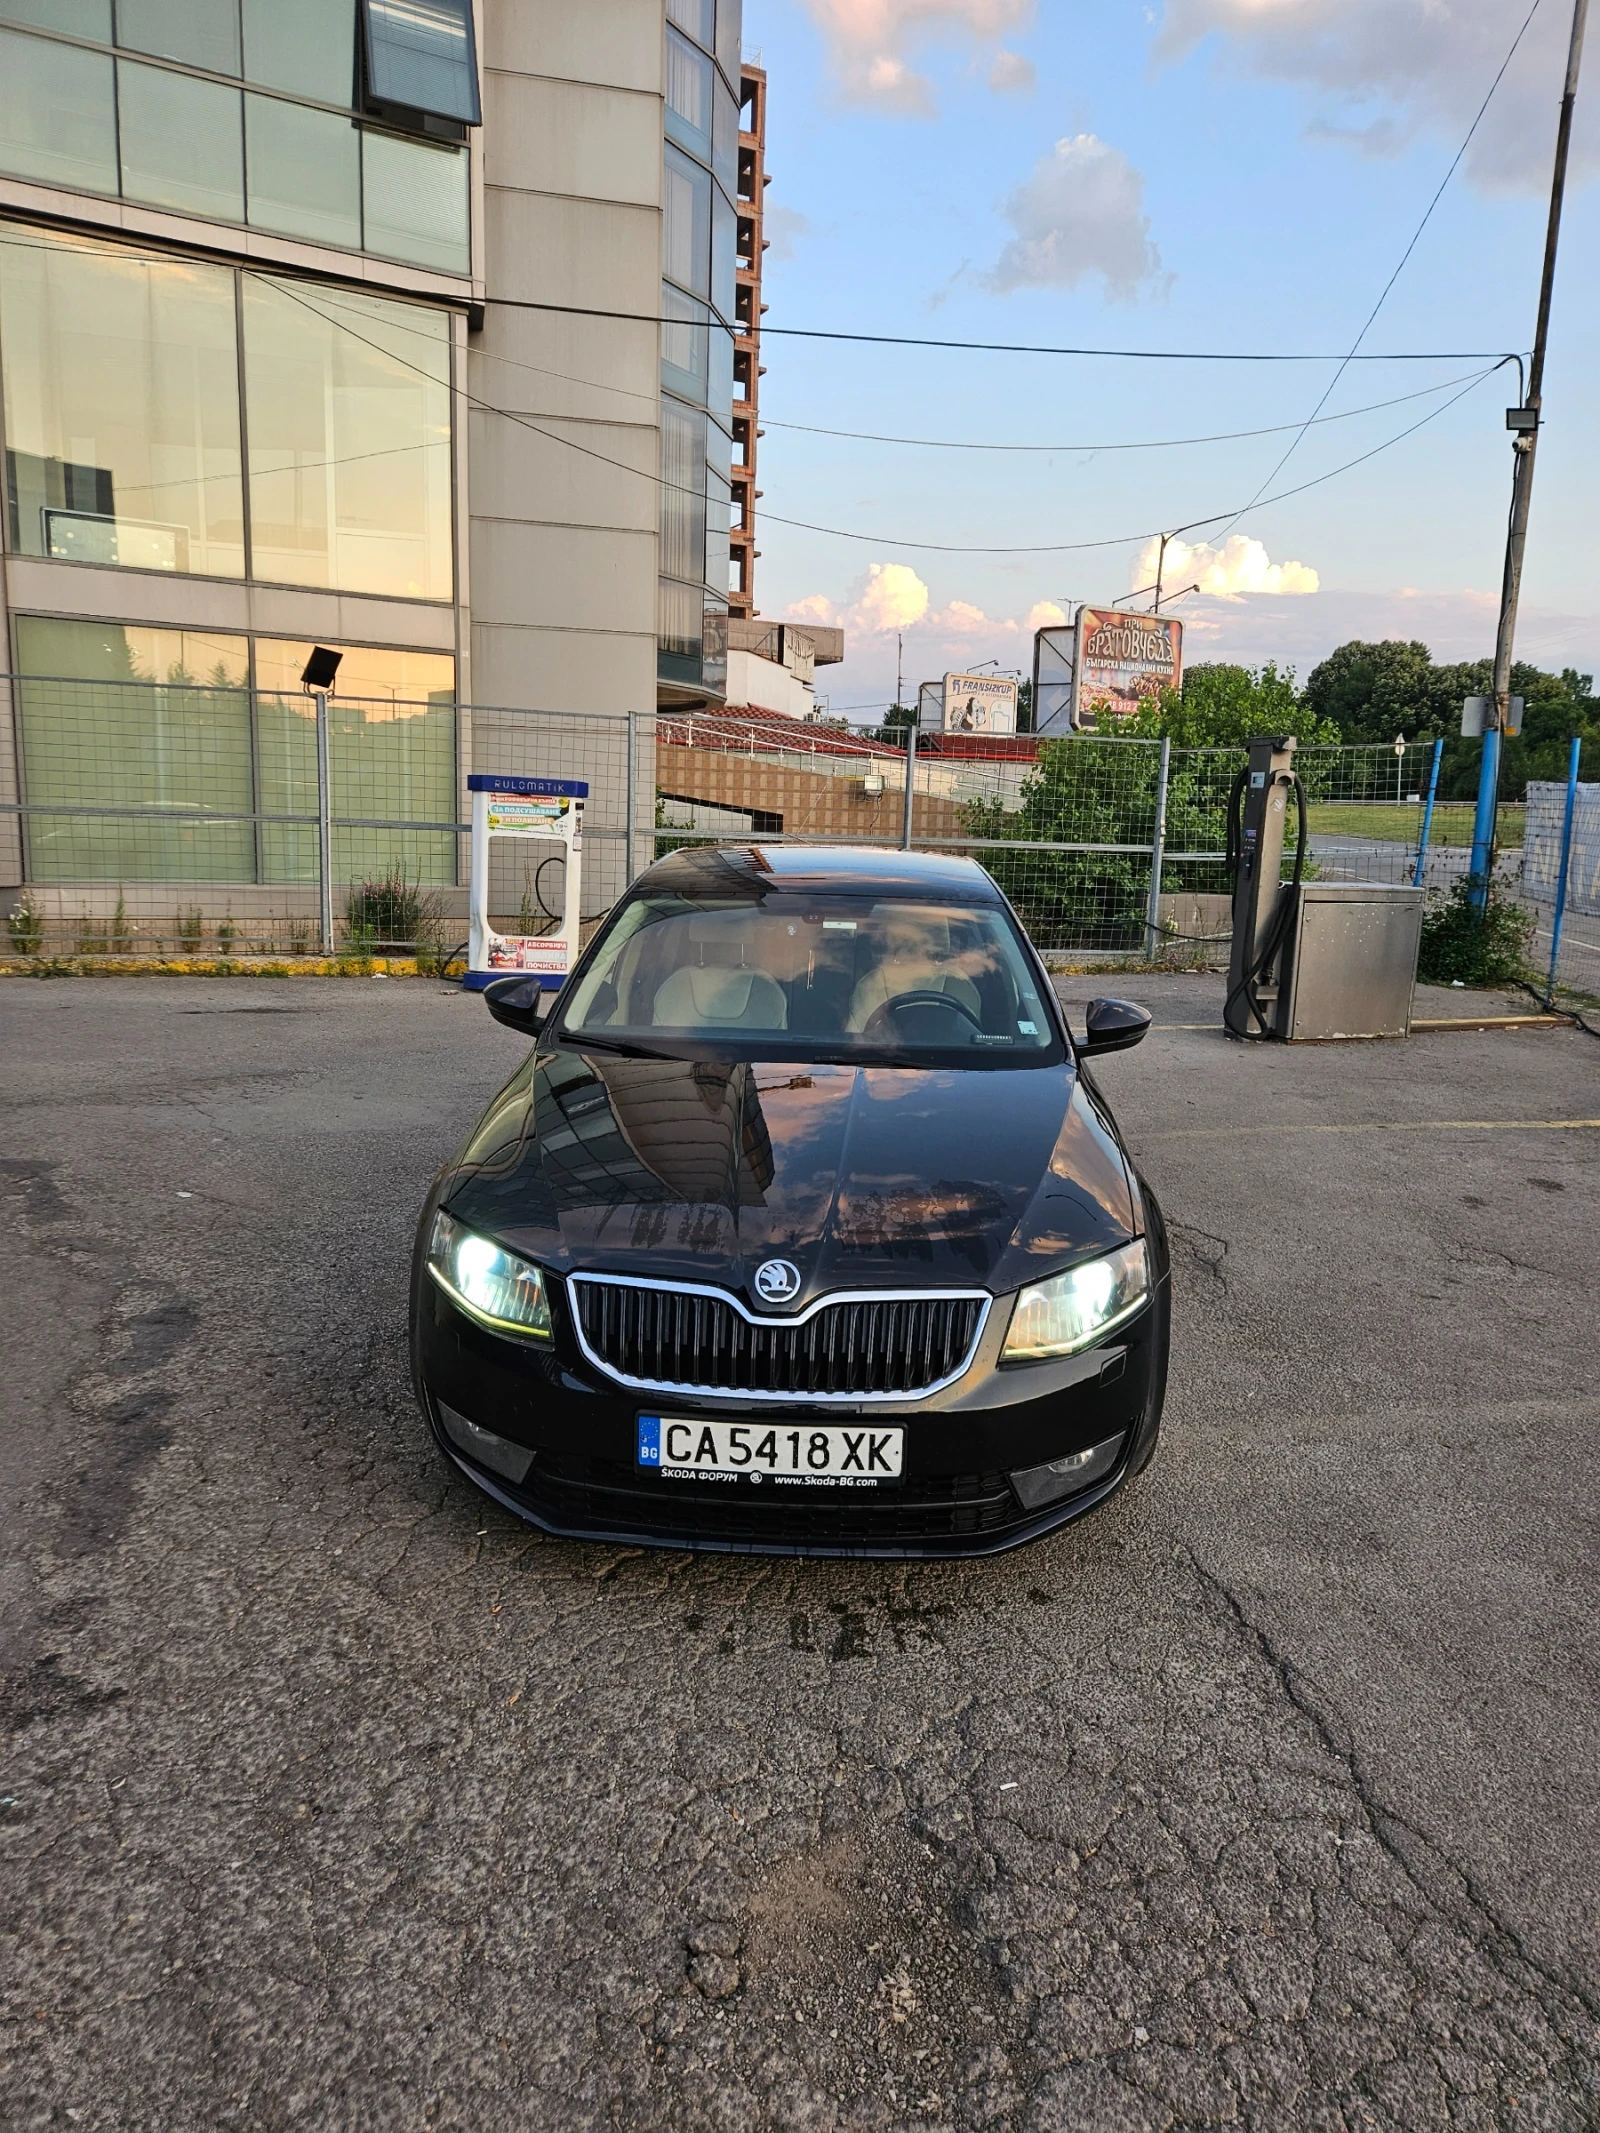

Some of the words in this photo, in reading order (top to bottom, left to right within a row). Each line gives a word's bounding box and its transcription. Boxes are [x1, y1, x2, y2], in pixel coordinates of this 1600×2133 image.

[1124, 618, 1143, 630] ПРИ
[1087, 622, 1175, 662] БРАТОВЧЕДА
[1086, 657, 1118, 669] БЪЛГАРСКА
[1119, 661, 1156, 673] НАЦИОНАЛНА
[1156, 665, 1174, 675] КУХНЯ
[1118, 701, 1131, 711] 912
[504, 807, 560, 815] ПОДСУШАВАНЕ
[527, 941, 567, 949] АБСОРБИРА
[527, 962, 566, 970] ПОЧИСТВА
[641, 1446, 658, 1459] BG
[661, 1467, 696, 1480] ŠKODA
[698, 1472, 738, 1482] ФОРУМ
[774, 1475, 878, 1487] www.Skoda-BG.com
